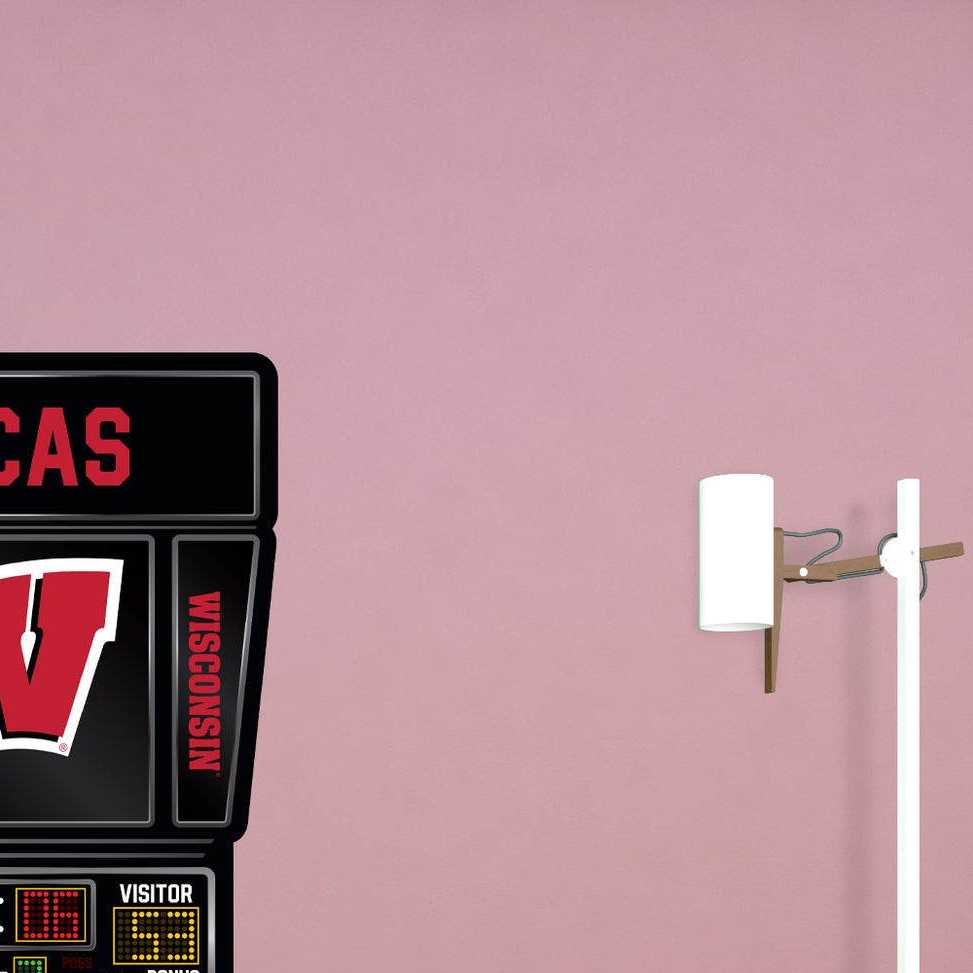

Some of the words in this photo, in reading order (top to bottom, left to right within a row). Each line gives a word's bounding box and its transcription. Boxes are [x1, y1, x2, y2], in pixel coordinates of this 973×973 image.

[188, 591, 221, 771] WISCONSIN
[119, 883, 193, 903] VISITOR
[131, 911, 195, 960] 53
[62, 957, 93, 969] POSS
